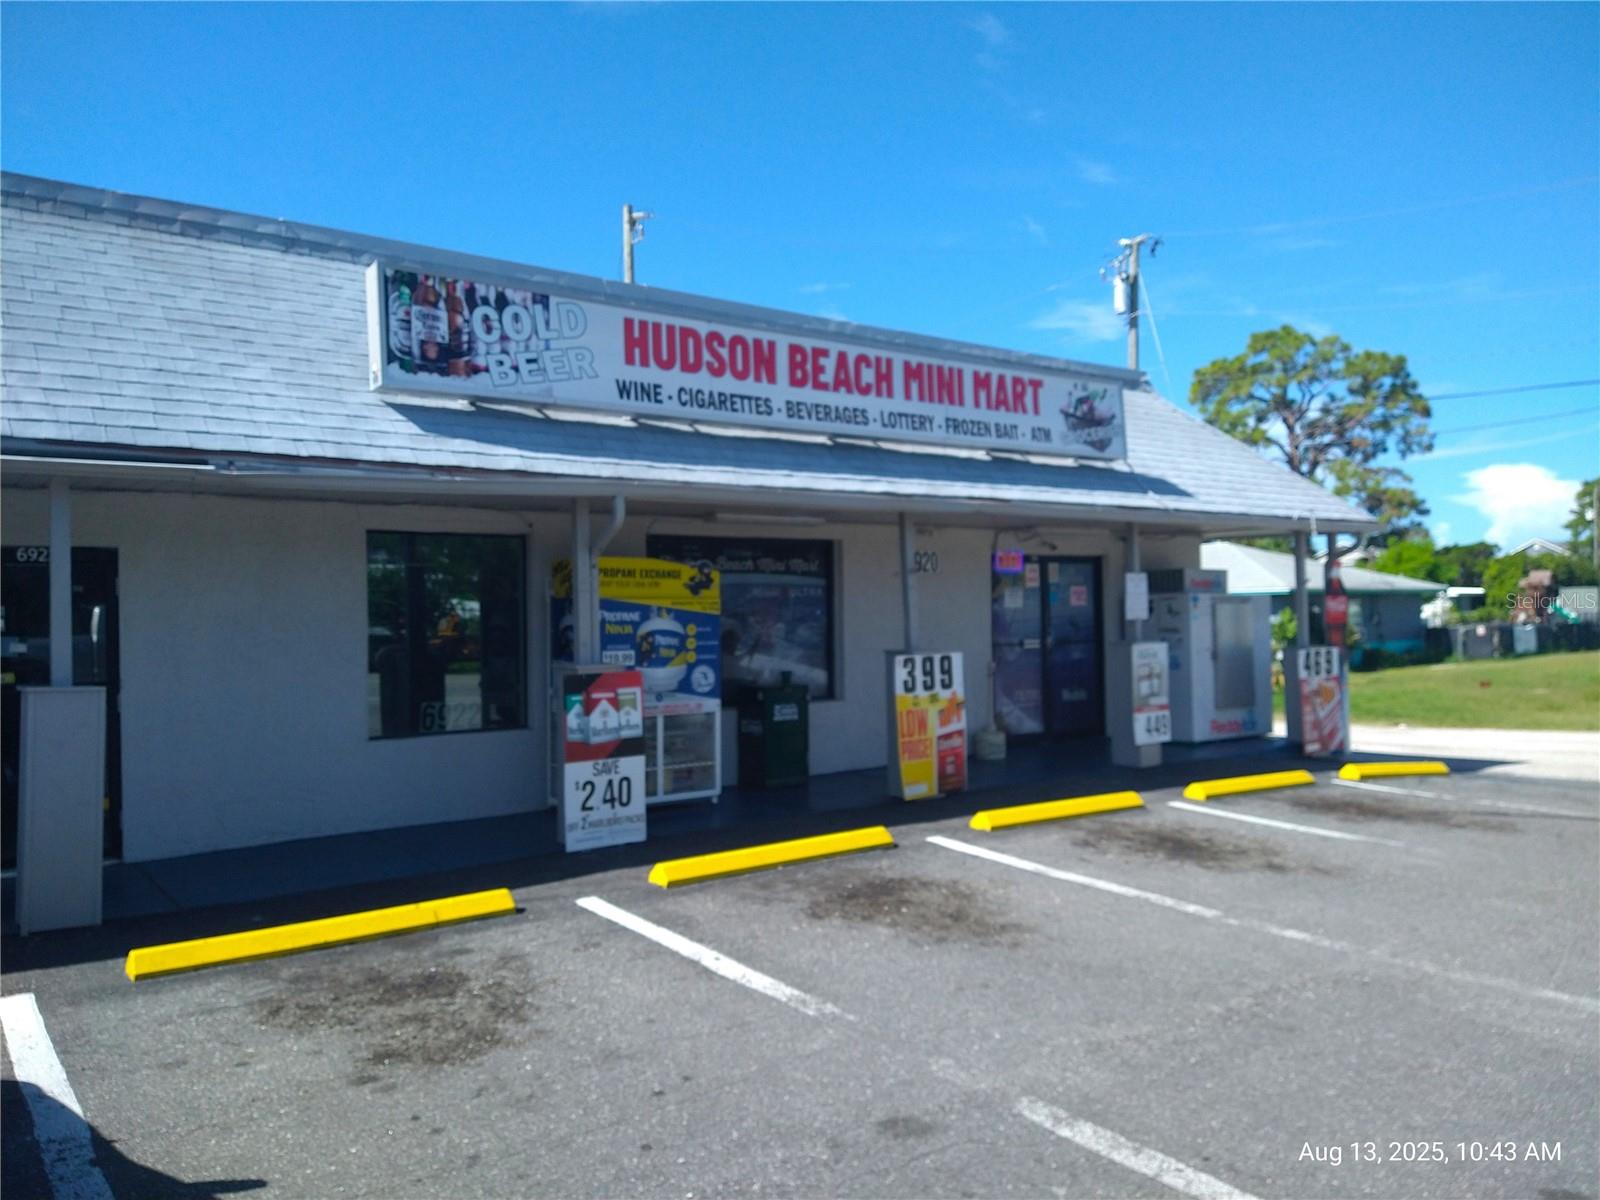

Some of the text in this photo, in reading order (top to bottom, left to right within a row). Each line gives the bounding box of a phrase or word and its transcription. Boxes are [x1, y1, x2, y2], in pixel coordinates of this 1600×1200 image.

[471, 301, 588, 343] COLD
[486, 346, 600, 388] BEER
[623, 316, 1044, 416] HUDSON BEACH MINI MART
[615, 378, 664, 404] WINE
[677, 386, 774, 416] CIGARETTES
[786, 403, 869, 427] BEVERAGES
[880, 412, 935, 433] LOTTERY
[945, 418, 992, 439] FROZEN
[995, 421, 1019, 440] BAIT
[1031, 424, 1053, 442] ATM
[598, 567, 682, 581] PROPANE EXCHANGE
[592, 759, 621, 777] SAVE
